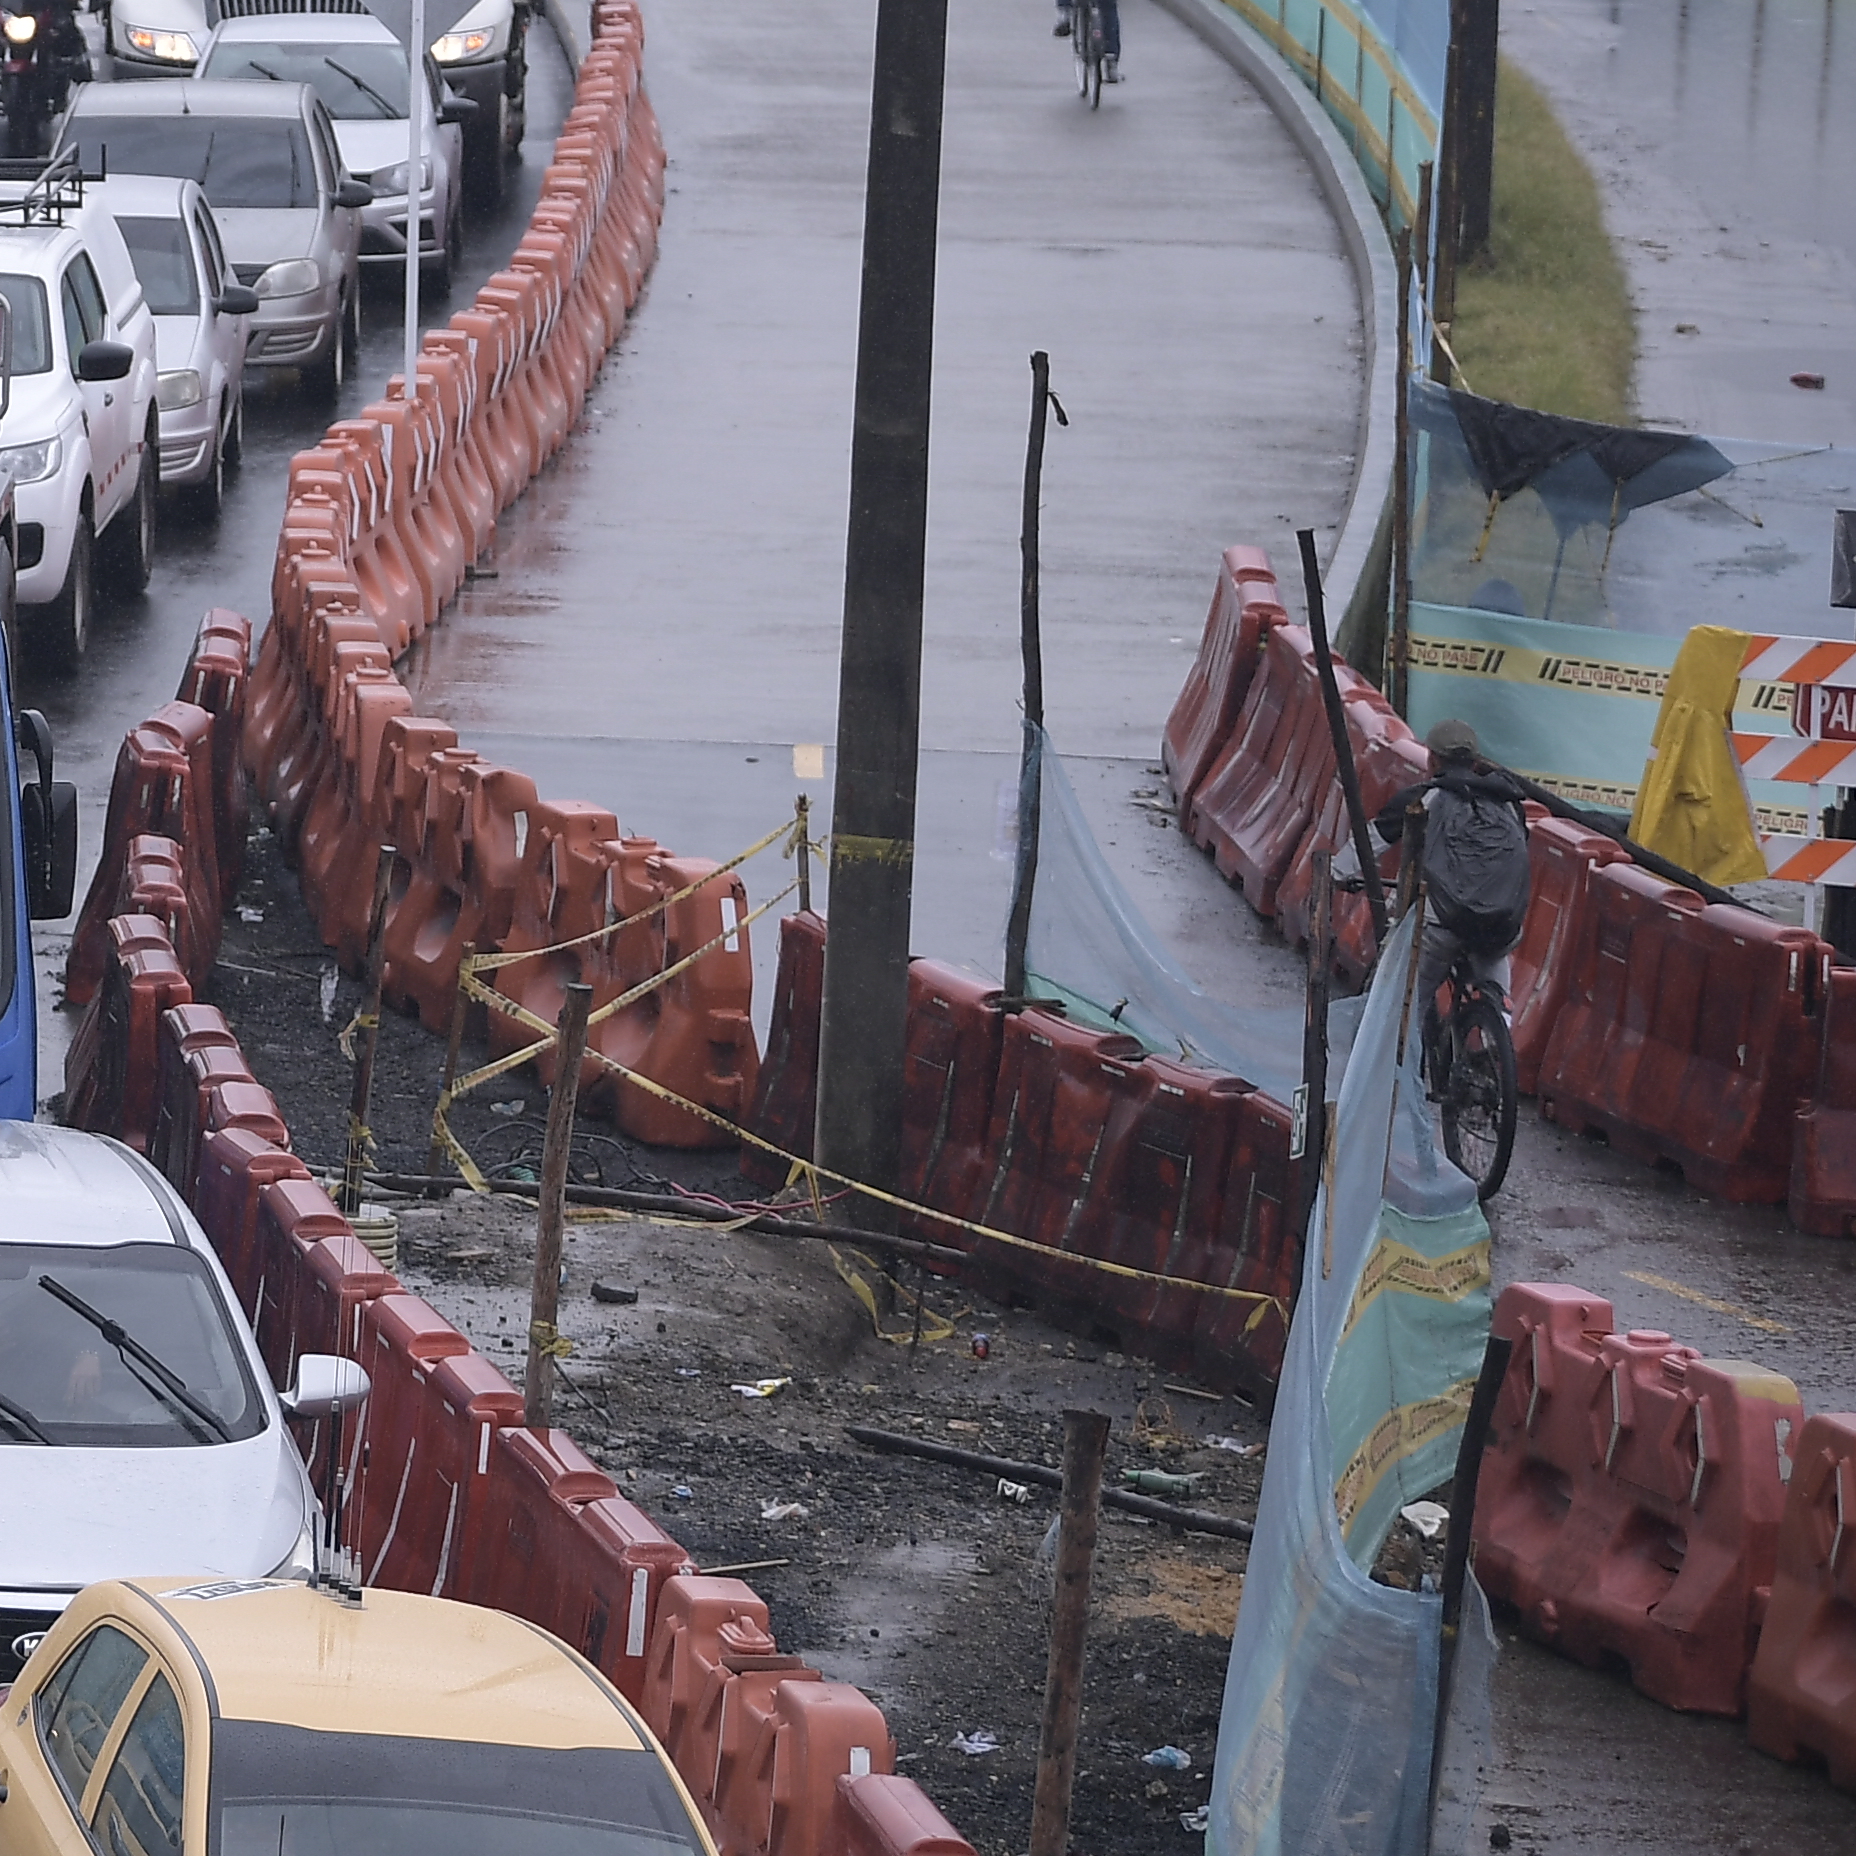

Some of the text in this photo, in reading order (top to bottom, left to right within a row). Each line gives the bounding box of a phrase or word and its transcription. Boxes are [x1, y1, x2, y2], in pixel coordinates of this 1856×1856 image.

[1418, 646, 1441, 662] NO
[1441, 649, 1480, 666] PASE
[1560, 666, 1626, 687] PELIGRO
[1628, 674, 1652, 690] NO
[1819, 690, 1856, 734] PA
[1754, 812, 1808, 831] PELIGR
